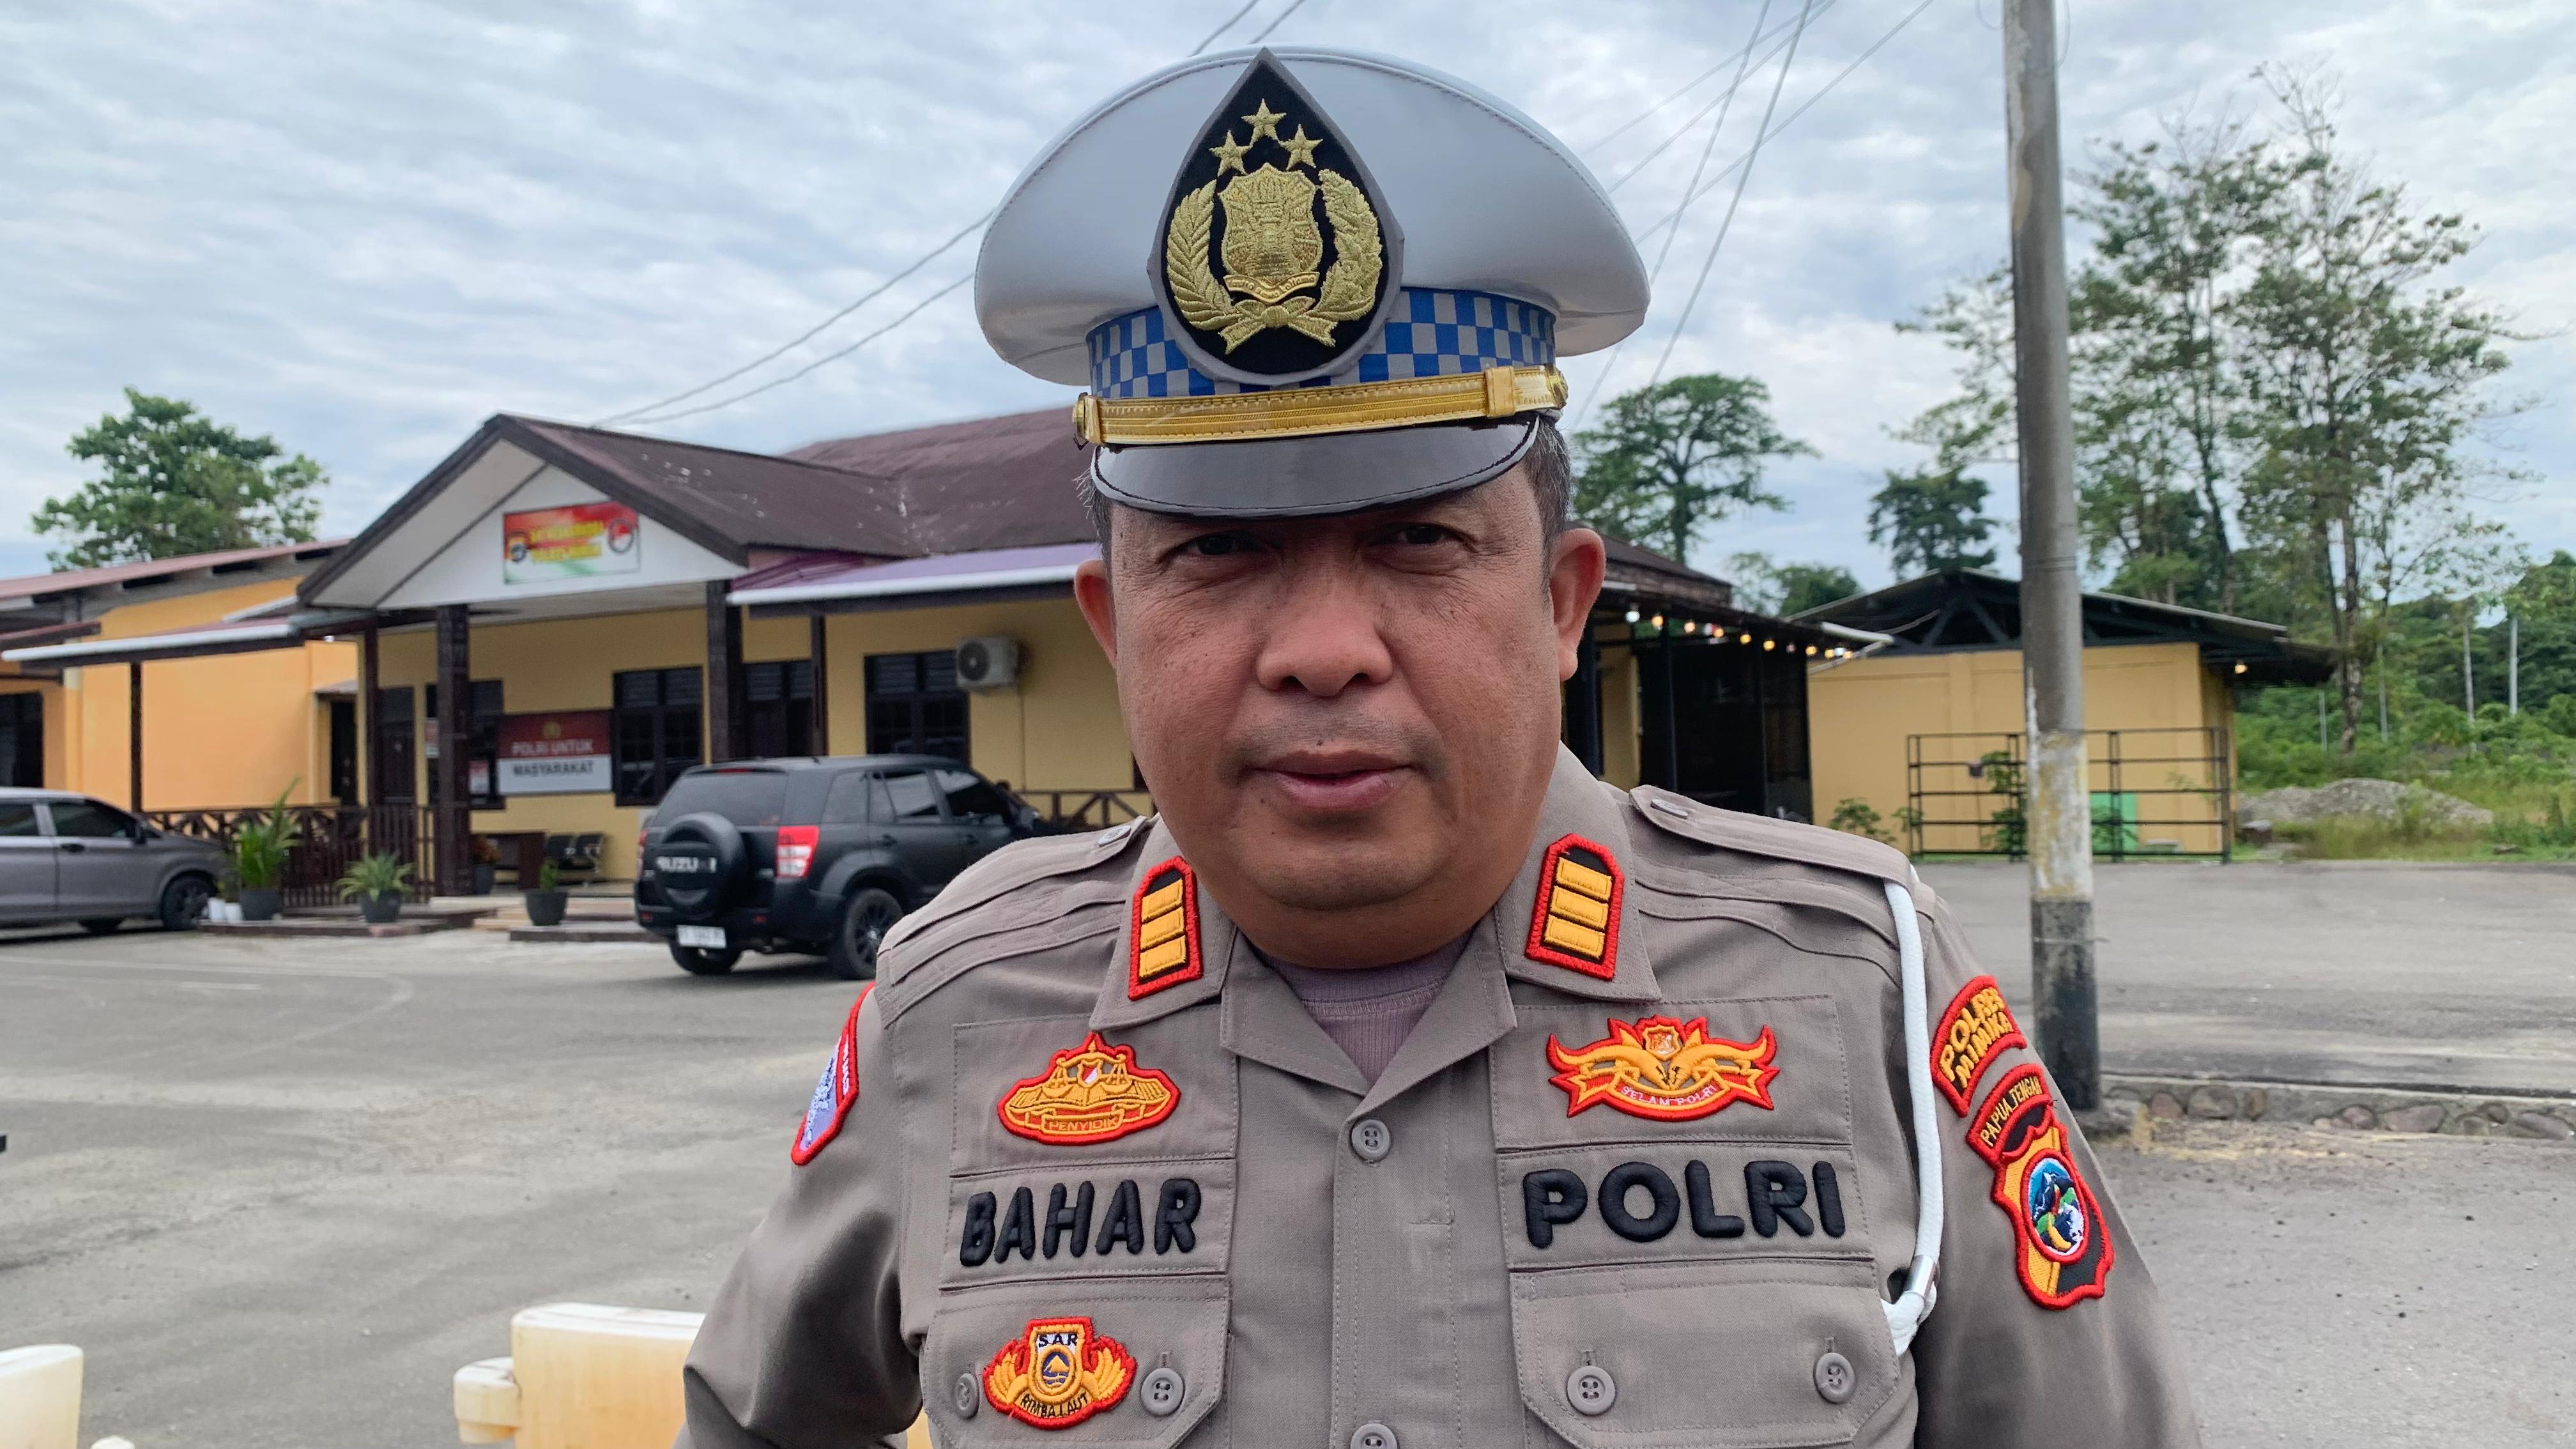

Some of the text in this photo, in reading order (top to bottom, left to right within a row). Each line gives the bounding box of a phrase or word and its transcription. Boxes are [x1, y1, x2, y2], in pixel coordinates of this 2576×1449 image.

[513, 760, 593, 776] MASYARAKAT
[1955, 1011, 2014, 1089] MIMIKA
[1621, 1084, 1717, 1106] SELAM POLRI
[1048, 1116, 1118, 1131] PENYIDIK
[1980, 1098, 2013, 1147] PAPUA
[1522, 1160, 1846, 1249] POLRI
[960, 1178, 1201, 1267] BAHAR
[1038, 1333, 1078, 1347] SAR
[1020, 1392, 1088, 1418] RIMBA LAUT
